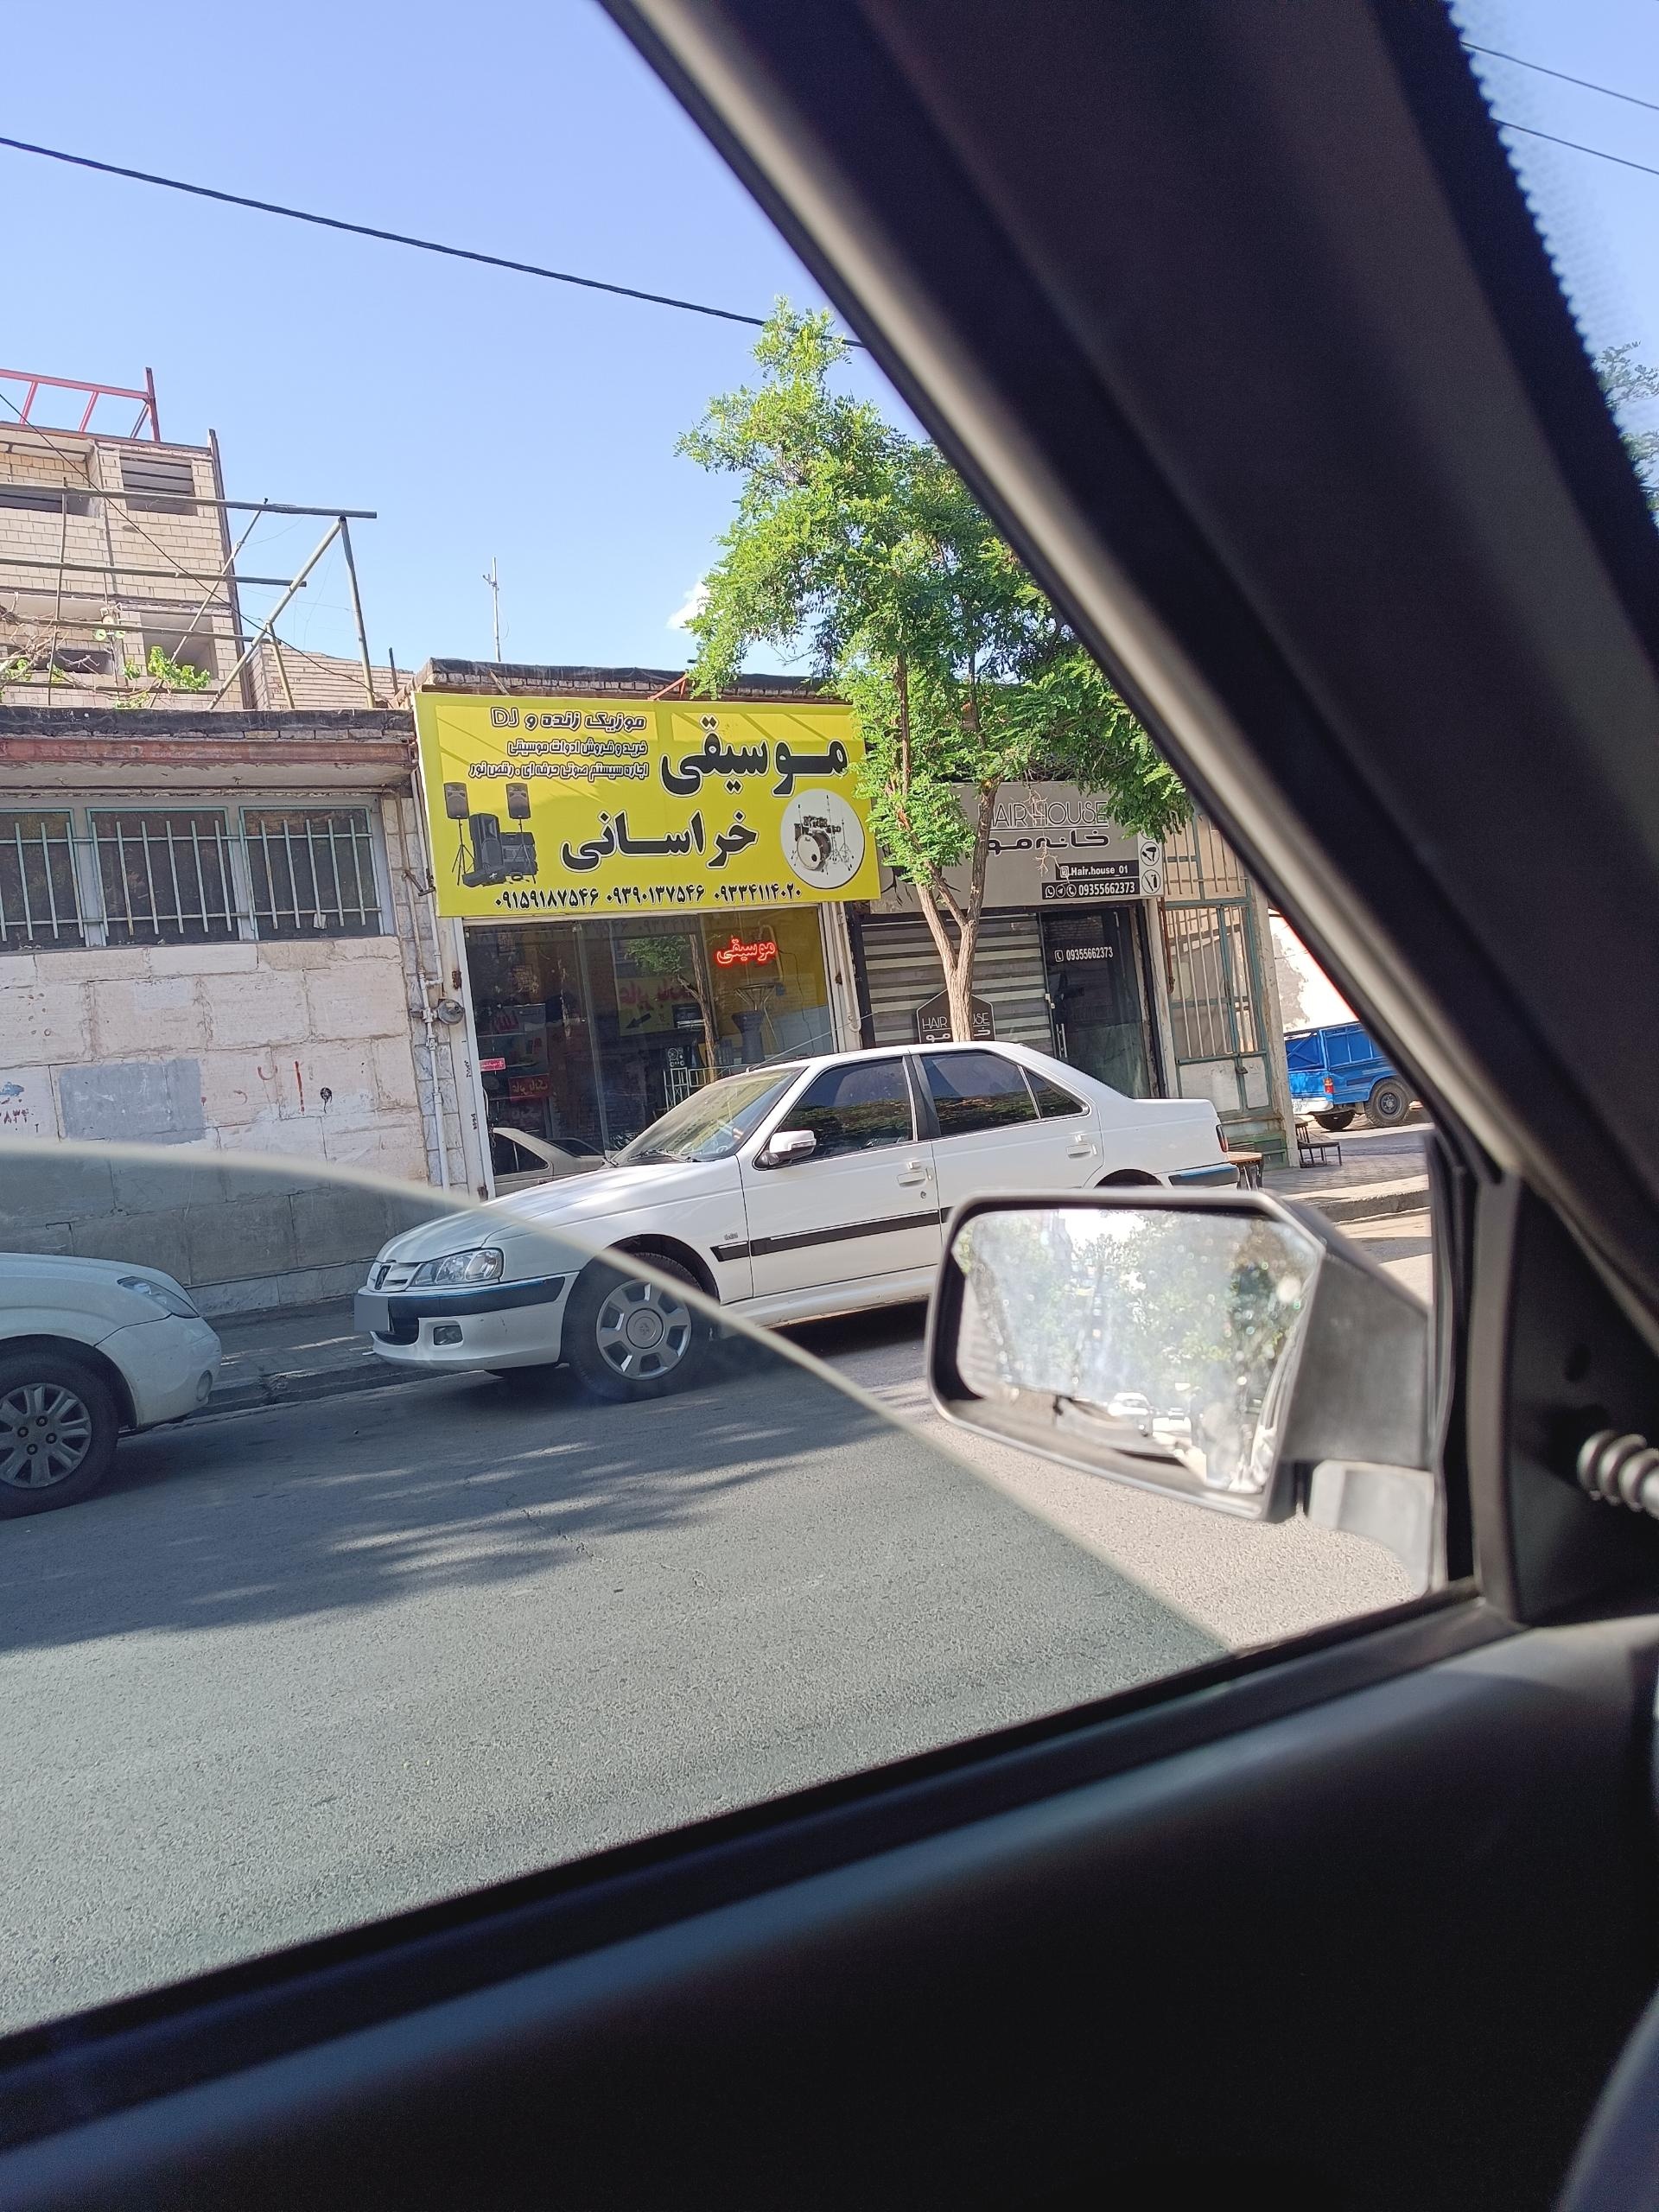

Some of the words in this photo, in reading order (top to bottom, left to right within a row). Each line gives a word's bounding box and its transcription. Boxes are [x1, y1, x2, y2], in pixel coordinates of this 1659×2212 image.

[491, 707, 519, 727] DJ
[524, 713, 538, 731] و
[542, 711, 581, 731] زنده
[586, 712, 646, 733] موزیک
[508, 739, 548, 755] موسیقی
[550, 740, 580, 755] ادوات
[582, 739, 614, 756] فروش
[614, 745, 621, 757] و
[622, 741, 648, 756] خرید
[661, 713, 849, 797] موسیقی
[469, 763, 487, 779] نور
[488, 761, 515, 779] رقص
[561, 762, 588, 778] صوتی
[589, 763, 623, 782] سیستم
[624, 762, 648, 777] اجاره
[561, 809, 760, 872] خراسانی
[1036, 830, 1109, 849] خانه
[494, 887, 599, 908] ۰۹۱۵۹۱۸۷۵۴۶
[606, 884, 705, 906] ۰۹۳۹۰۱۳۷۵۴۶
[714, 882, 801, 901] ۰۹۳۳۴۱۱۴۰۲۰
[1078, 881, 1135, 896] 09355662373
[715, 938, 777, 965] موسیقی
[1065, 946, 1113, 961] 09355662373
[922, 1016, 948, 1030] HAIR
